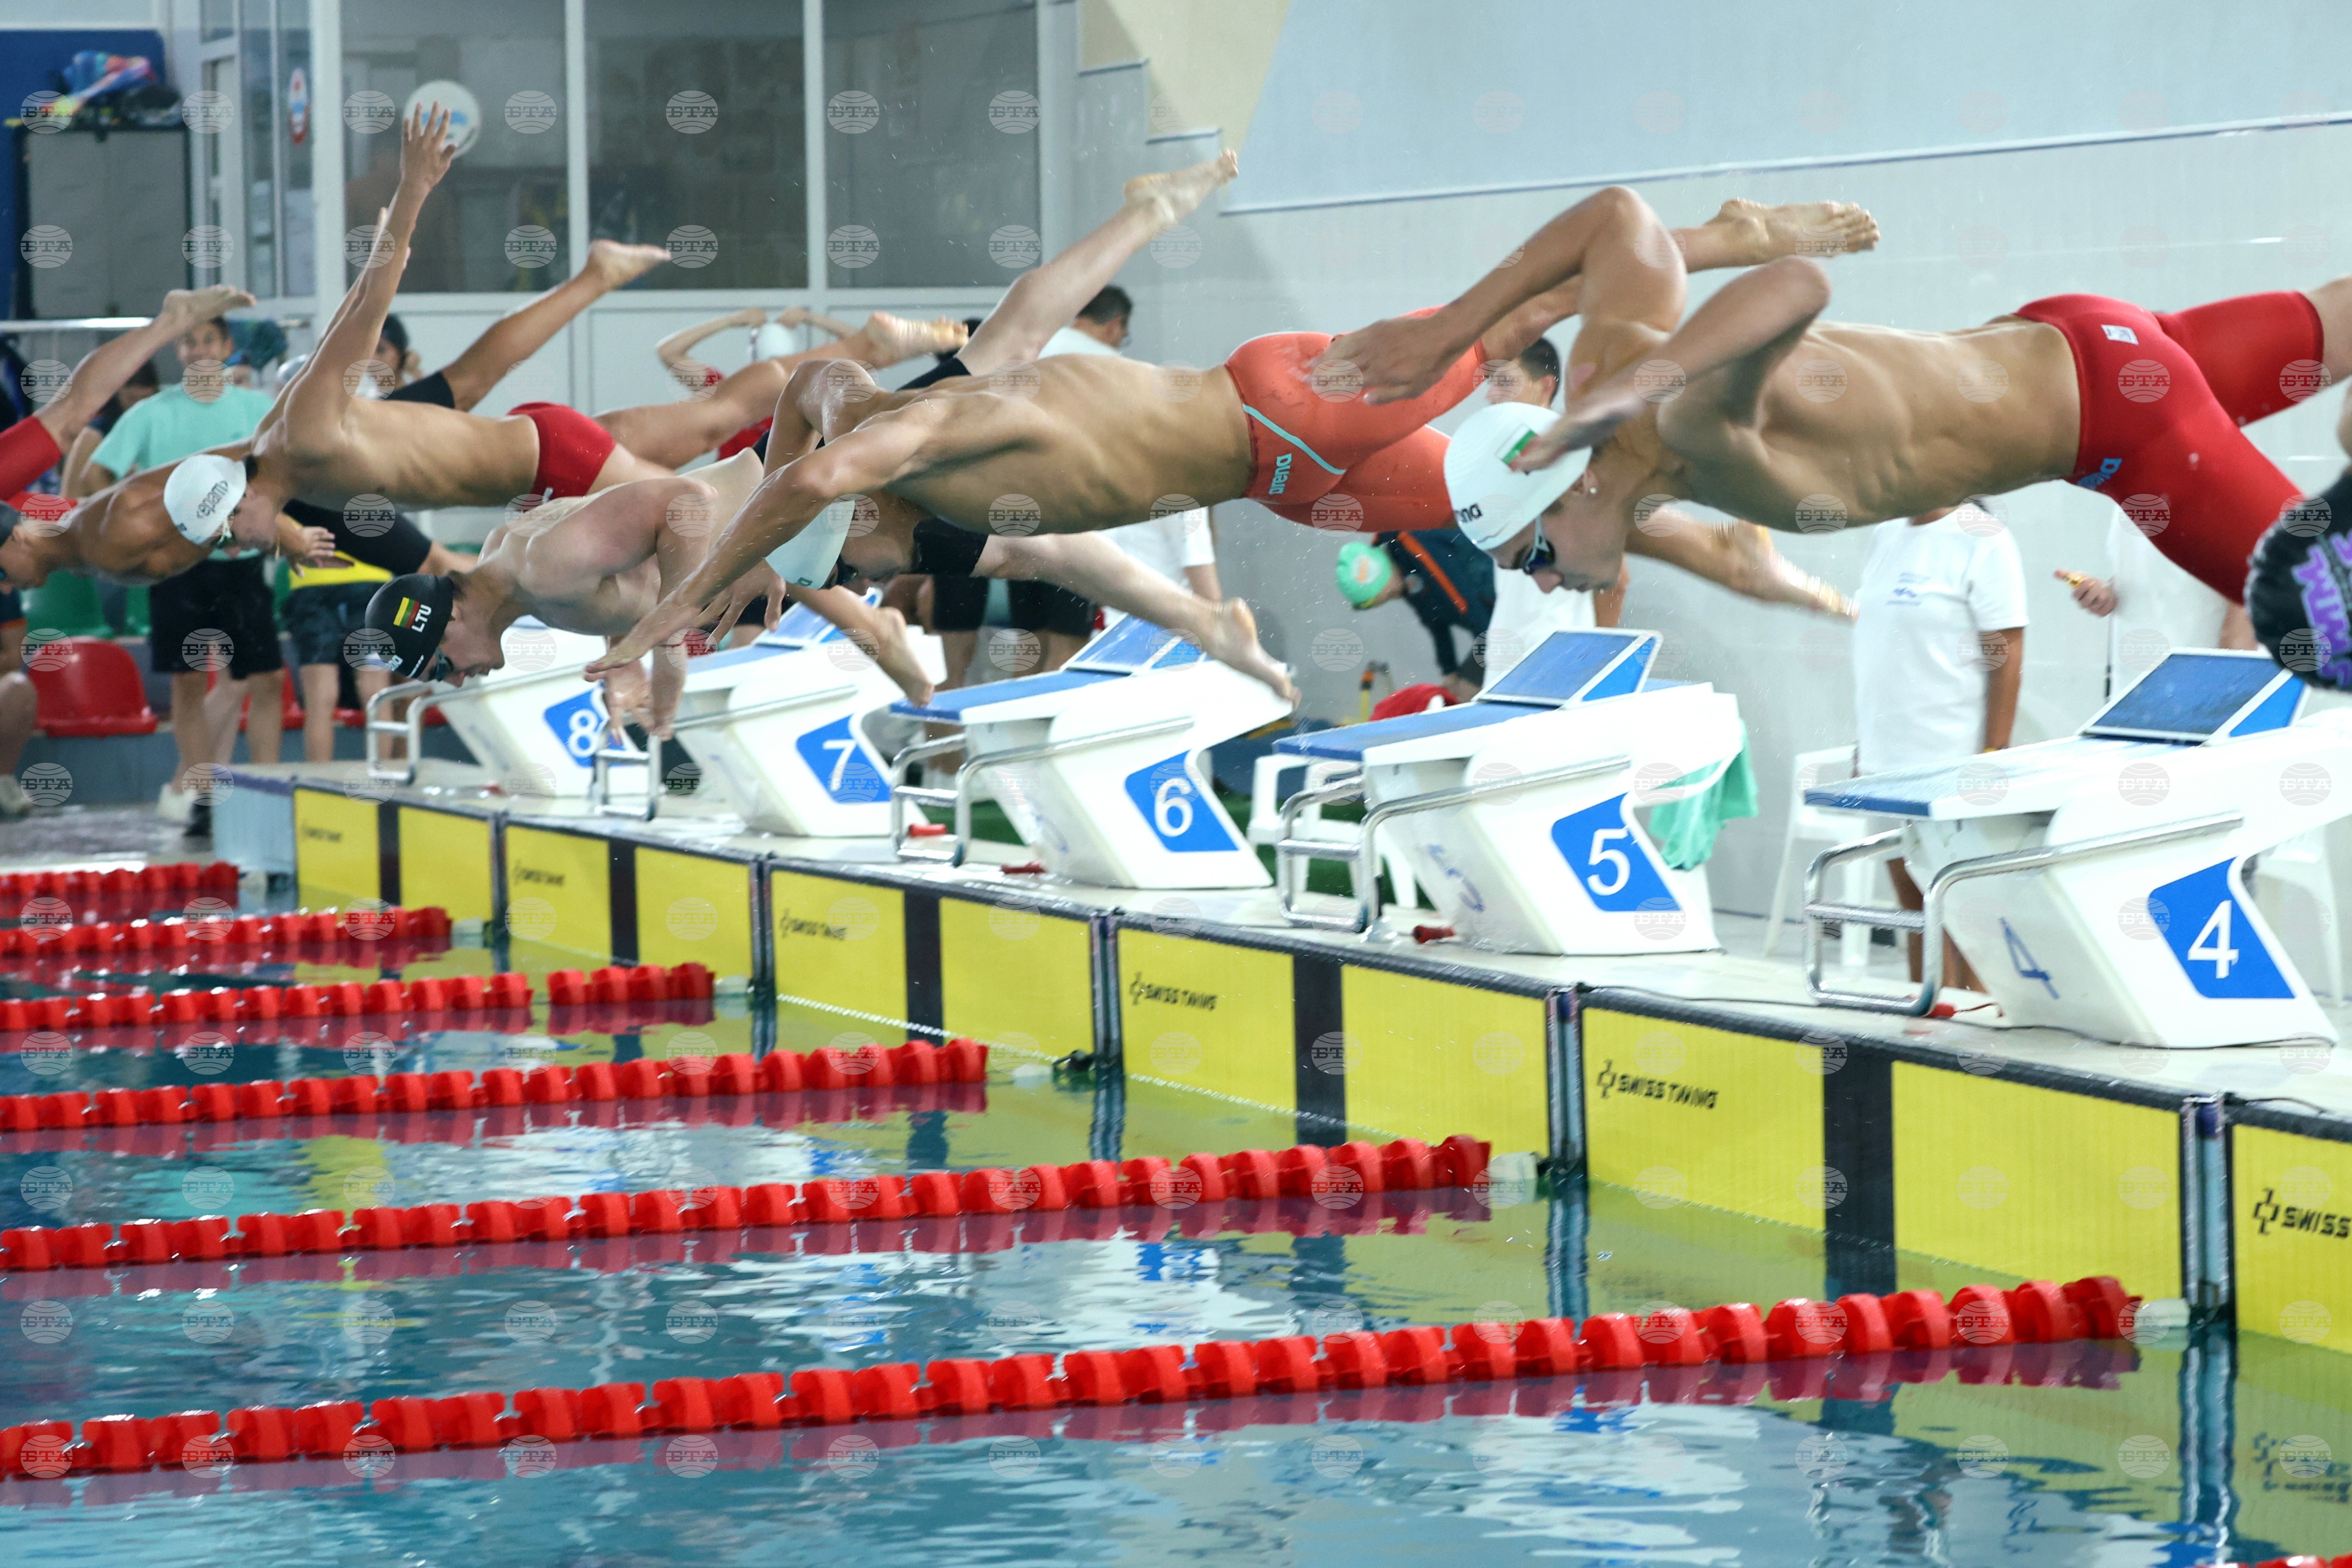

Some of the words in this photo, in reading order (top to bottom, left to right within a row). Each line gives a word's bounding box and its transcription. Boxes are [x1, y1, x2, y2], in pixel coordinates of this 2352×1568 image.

[1268, 453, 1292, 495] arena
[411, 604, 432, 633] LTU
[568, 708, 599, 757] 8
[823, 739, 859, 791] 7
[1154, 778, 1193, 837] 6
[1587, 828, 1630, 896] 5
[1998, 918, 2059, 999] 4
[2187, 899, 2240, 980] 4
[1617, 1074, 1666, 1099] SWISS
[2282, 1206, 2351, 1238] SWISS
